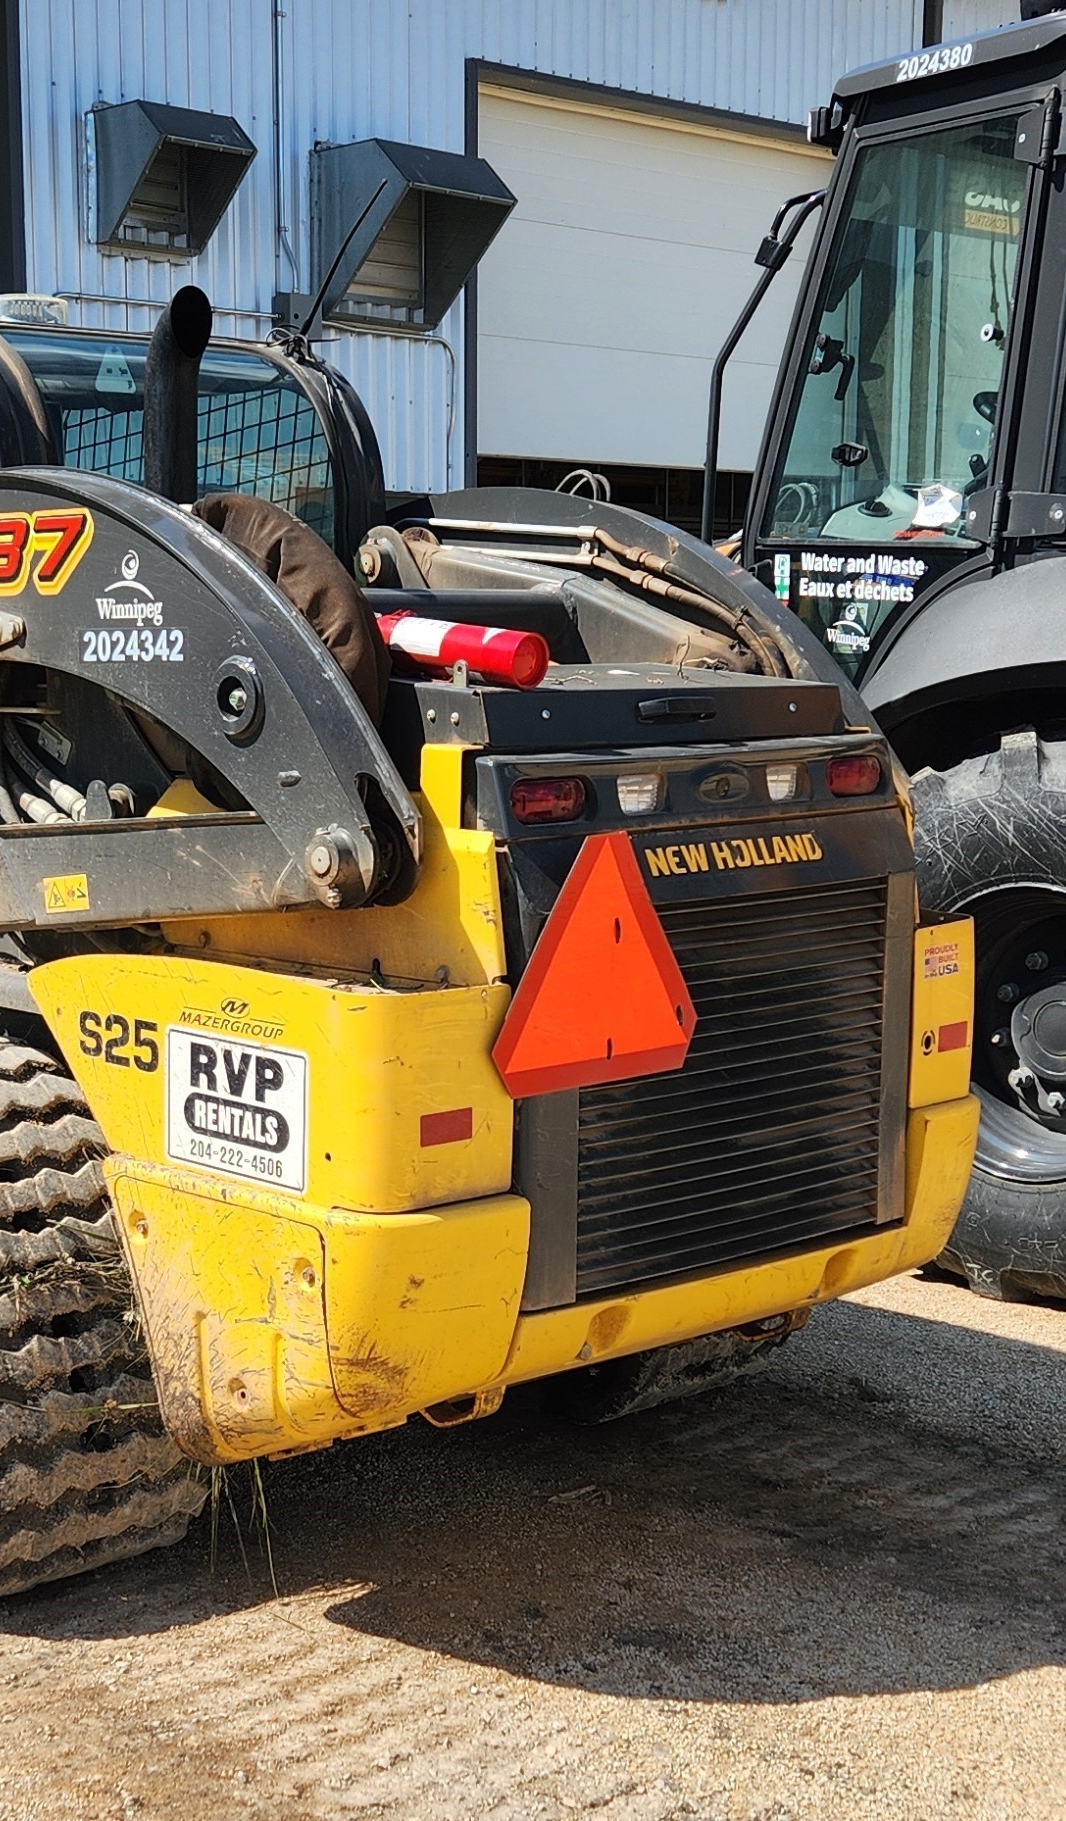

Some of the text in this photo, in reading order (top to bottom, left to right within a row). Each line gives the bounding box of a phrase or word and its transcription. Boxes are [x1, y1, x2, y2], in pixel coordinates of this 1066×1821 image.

[897, 43, 973, 82] 2024380
[801, 552, 924, 576] Water and Waste
[799, 578, 834, 598] Eaux
[836, 580, 853, 599] et
[854, 578, 914, 602] déchets
[95, 598, 163, 626] Winnipeg
[83, 629, 184, 662] 2024342
[827, 627, 870, 651] Winnipeg
[644, 833, 822, 877] NEW HOLLAND
[924, 943, 959, 956] PROUDLY
[938, 953, 959, 964] BUILT
[938, 962, 959, 976] USA
[178, 1011, 284, 1039] MAZERGROUP
[79, 1010, 159, 1073] S25
[190, 1041, 284, 1103] RVP
[194, 1098, 279, 1146] RENTALS
[190, 1138, 283, 1178] 204-222-4506
